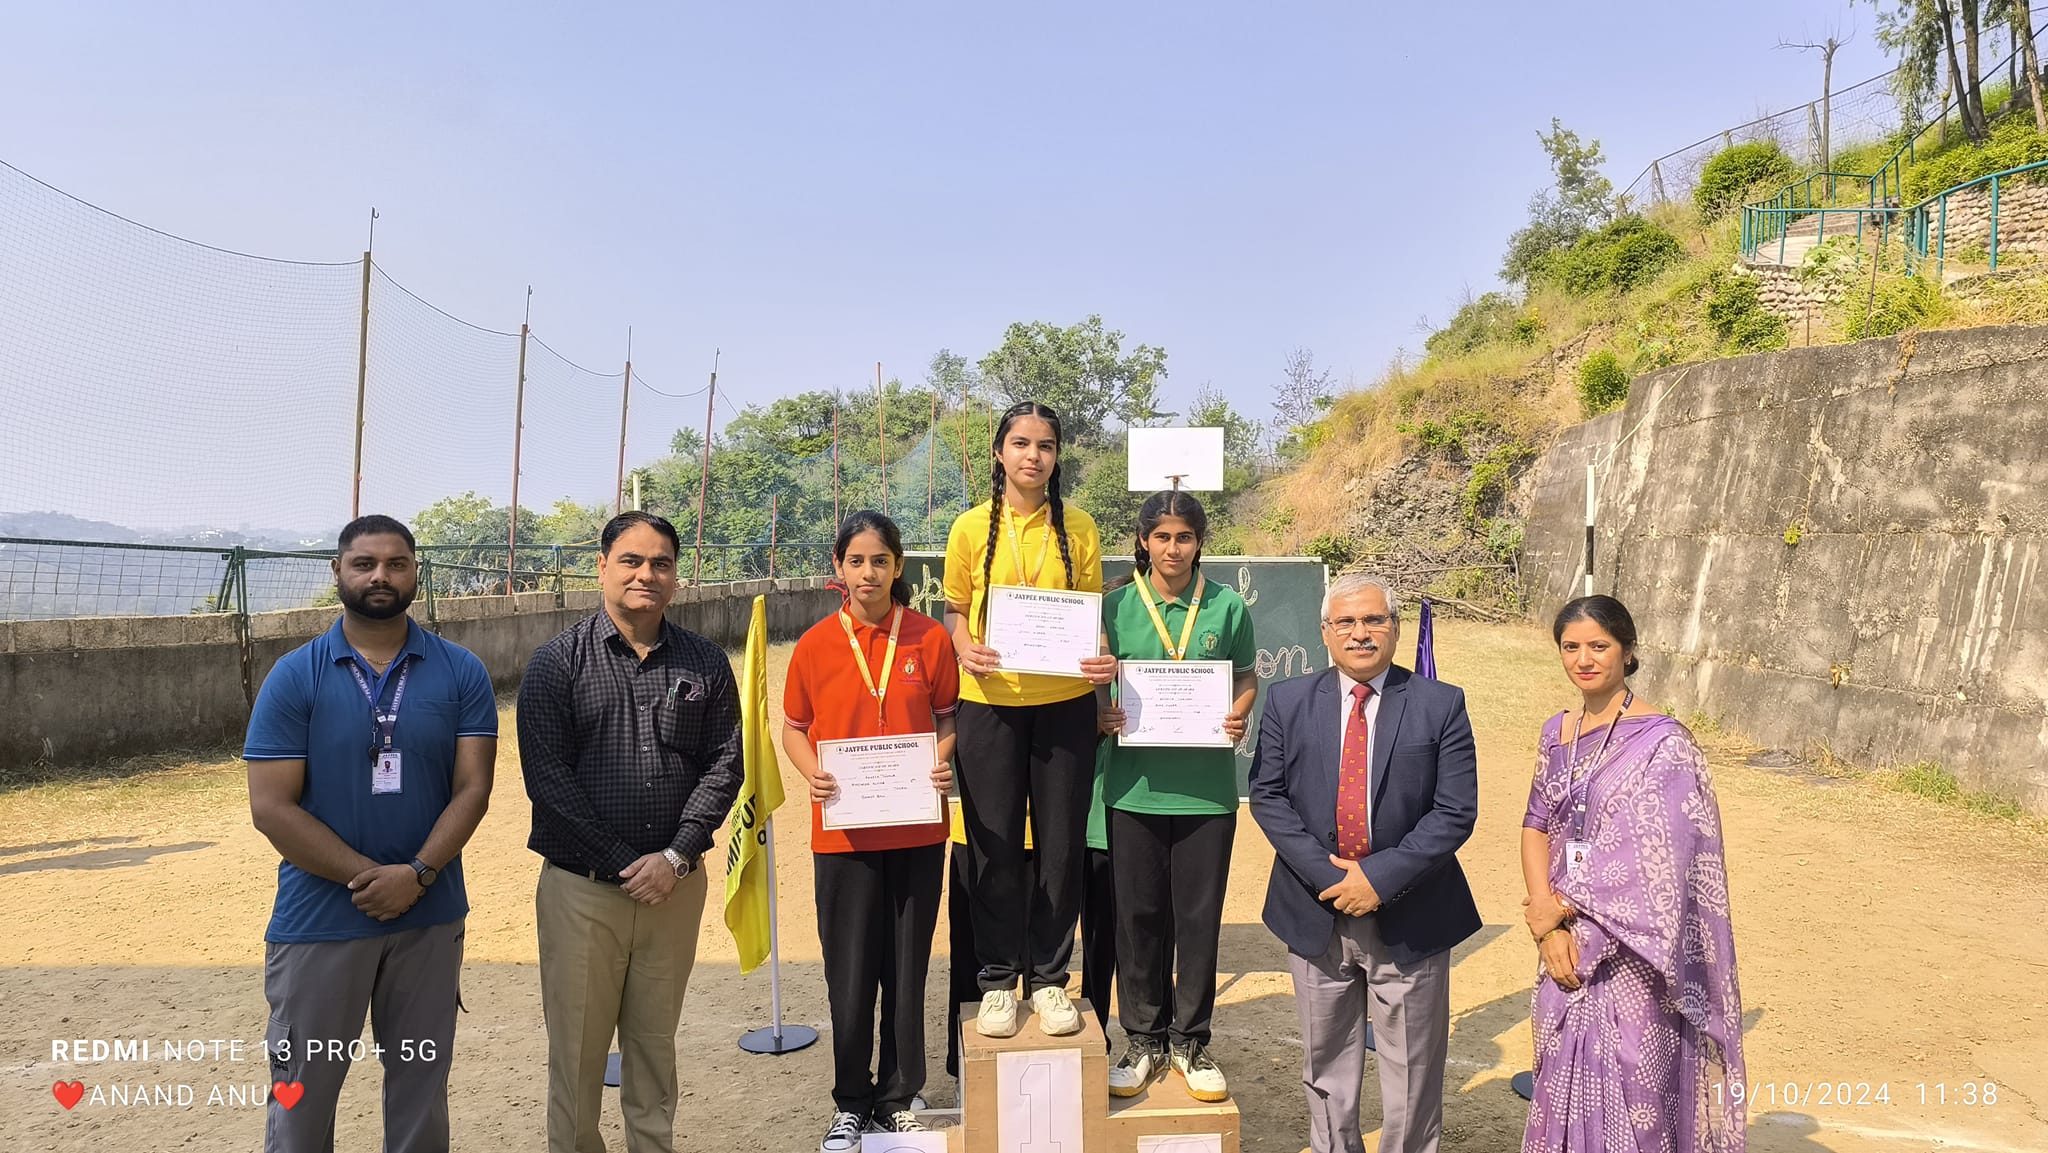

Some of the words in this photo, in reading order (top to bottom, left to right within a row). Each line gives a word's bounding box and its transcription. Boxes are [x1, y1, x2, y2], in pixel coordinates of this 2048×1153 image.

[1014, 593, 1037, 601] JAYPEE
[1038, 595, 1060, 603] PUBLIC
[1061, 597, 1085, 605] SCHOOL
[844, 745, 869, 753] JAYPEE
[870, 743, 893, 751] PUBLIC
[894, 741, 919, 749] SCHOOL
[1019, 1063, 1062, 1153] 1
